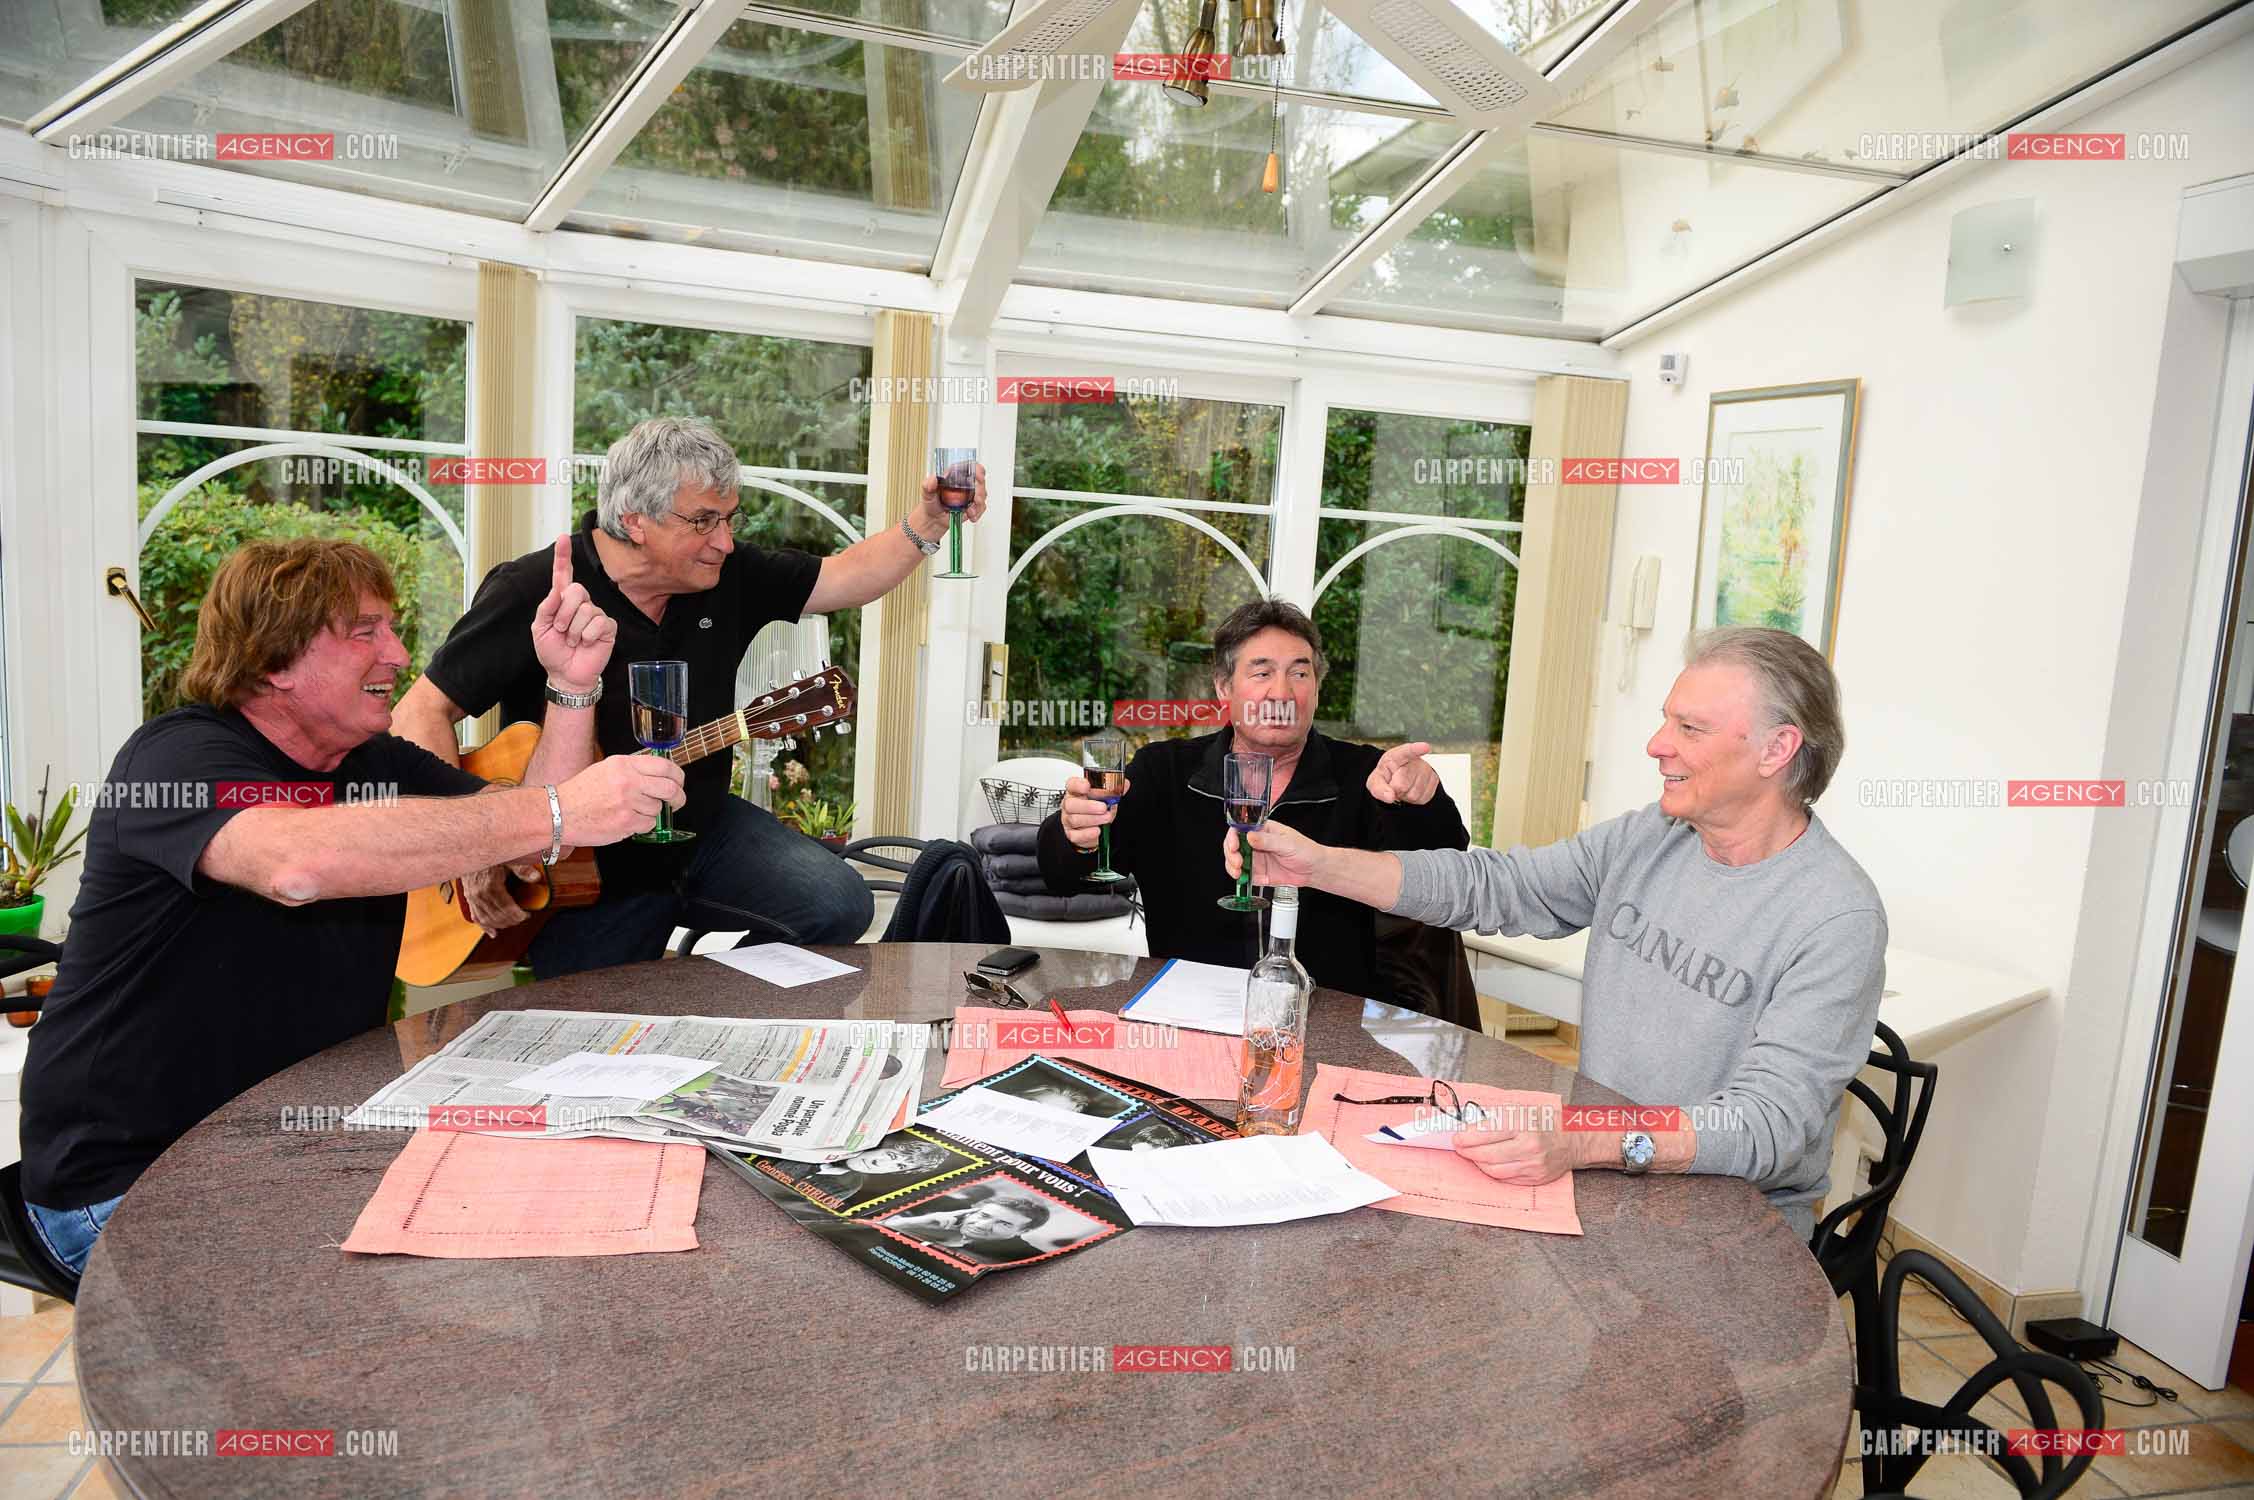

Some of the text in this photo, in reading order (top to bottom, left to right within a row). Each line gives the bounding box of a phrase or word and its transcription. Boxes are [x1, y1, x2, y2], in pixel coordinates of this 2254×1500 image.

[1606, 901, 1754, 1008] CANARD
[808, 1099, 826, 1109] Un
[994, 1153, 1040, 1175] pour
[1037, 1170, 1078, 1193] vous
